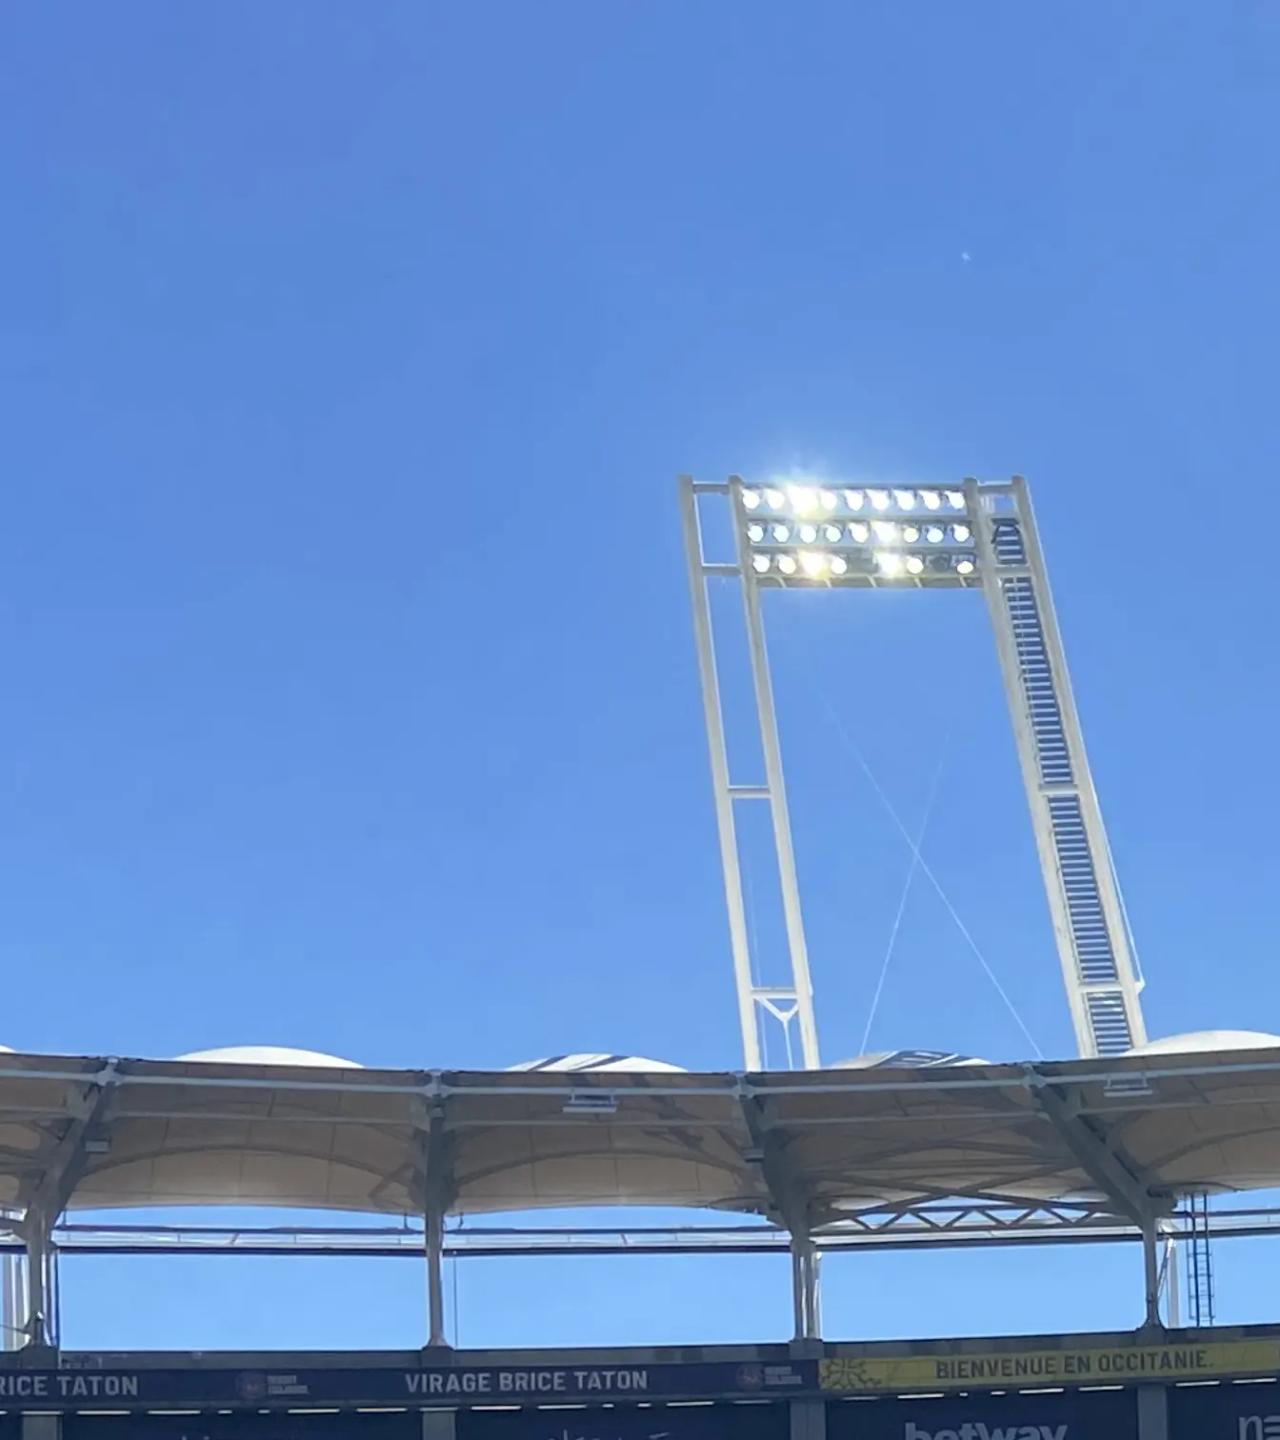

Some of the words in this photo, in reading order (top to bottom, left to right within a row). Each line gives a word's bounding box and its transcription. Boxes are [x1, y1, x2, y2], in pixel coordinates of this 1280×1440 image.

[936, 1356, 1057, 1380] BIENVENUE
[1064, 1353, 1091, 1375] EN
[1099, 1350, 1213, 1372] OCCITANIE.
[57, 1375, 138, 1396] TATON
[405, 1373, 492, 1393] VIRAGE
[500, 1371, 566, 1392] BRICE
[574, 1370, 649, 1391] TATON
